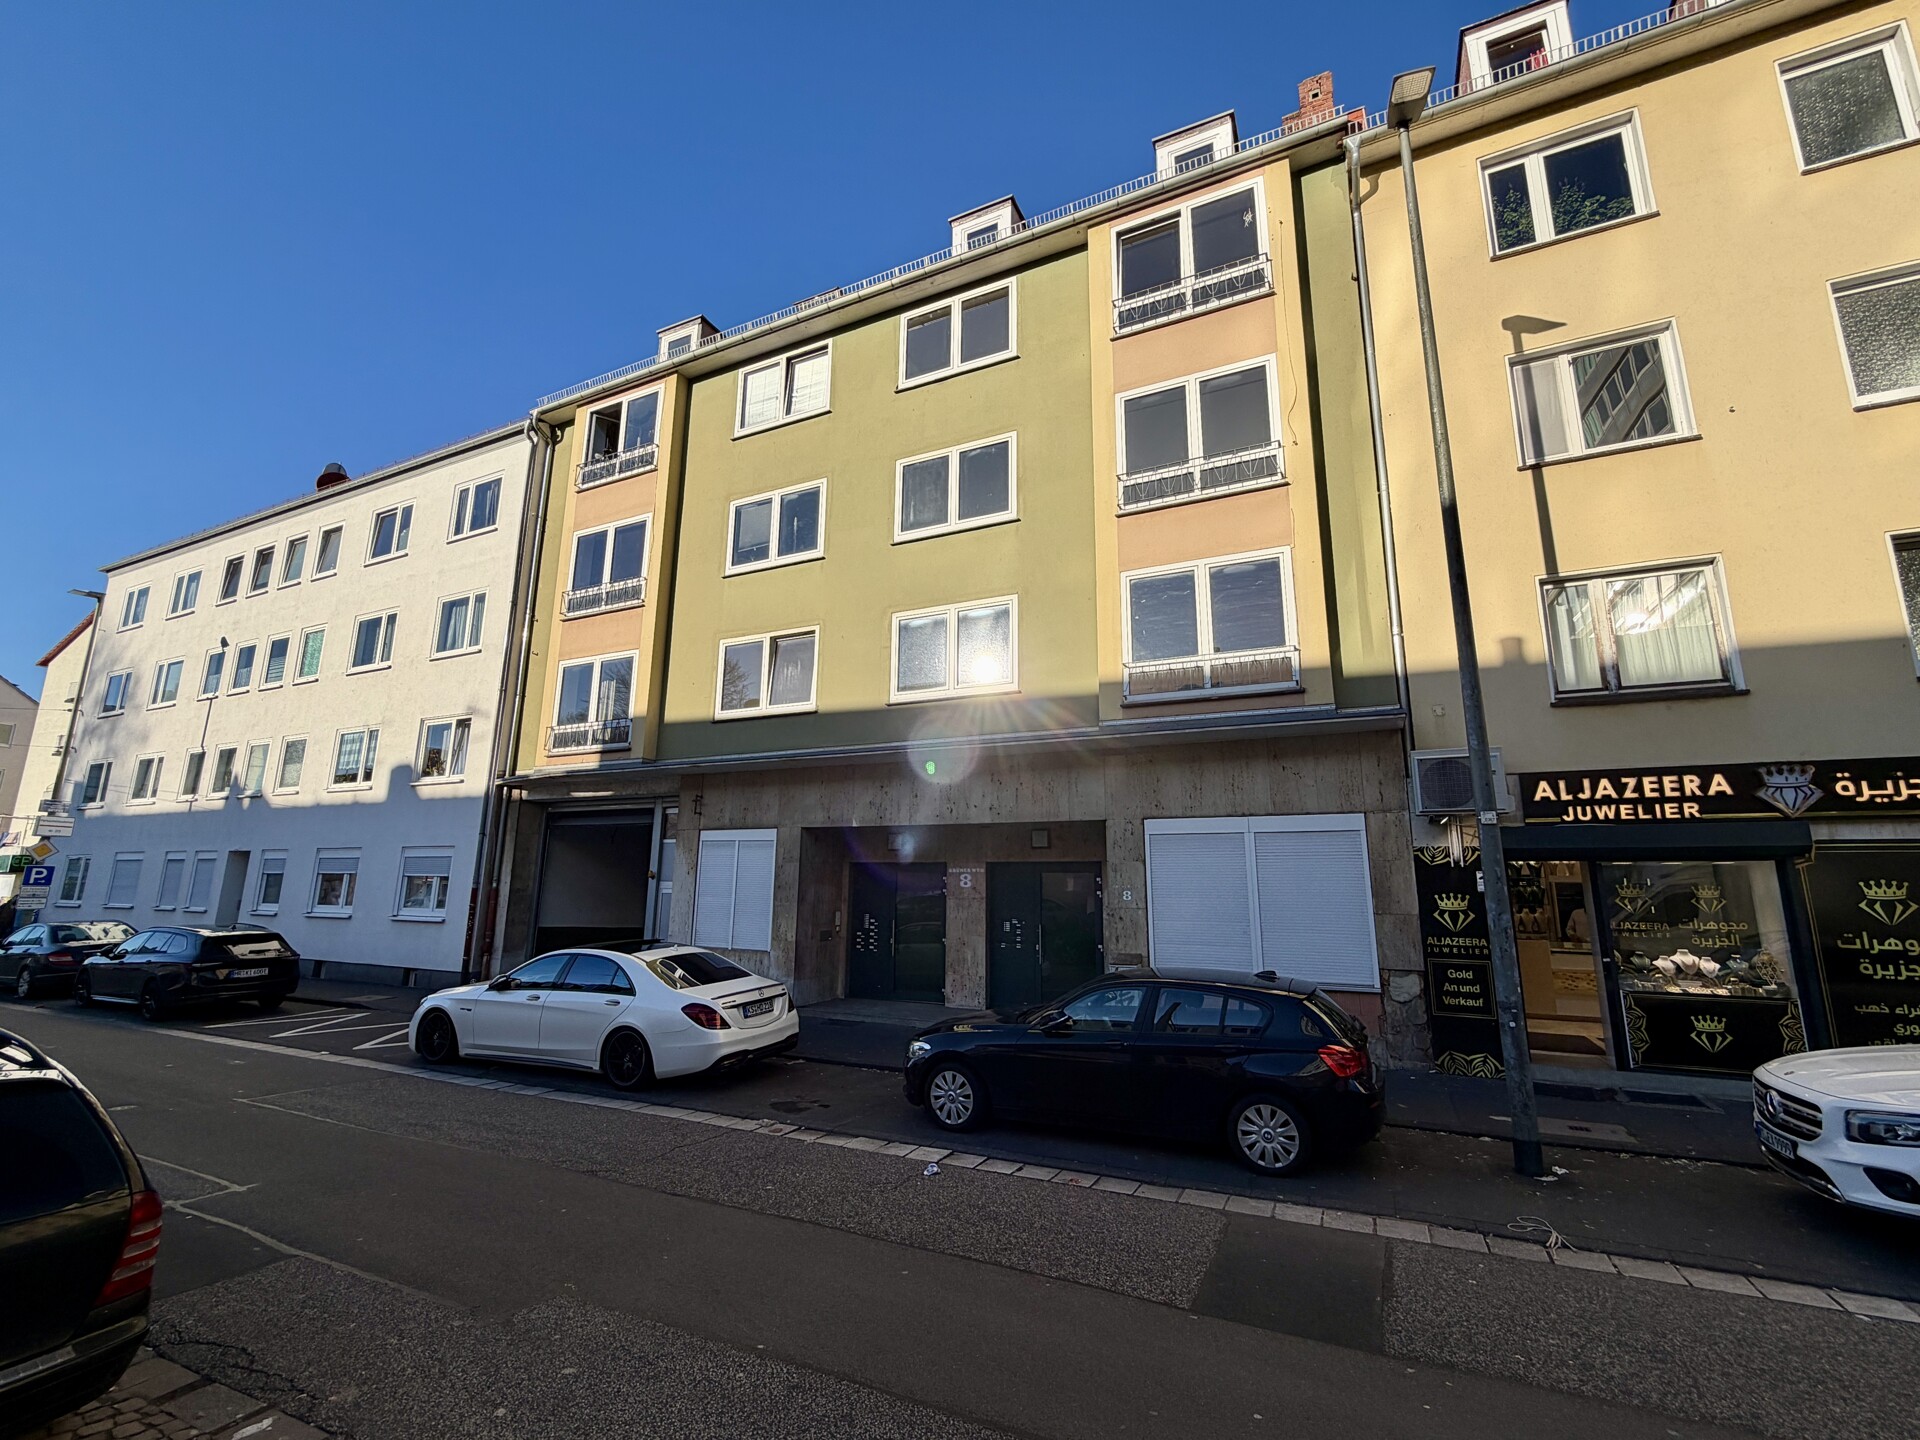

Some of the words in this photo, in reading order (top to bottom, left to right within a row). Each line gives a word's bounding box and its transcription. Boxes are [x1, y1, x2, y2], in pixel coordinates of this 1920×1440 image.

[1533, 773, 1734, 802] ALJAZEERA
[1562, 802, 1701, 821] JUWELIER
[29, 867, 48, 884] P
[960, 873, 972, 888] 8
[1122, 890, 1132, 901] 8
[1610, 921, 1670, 931] LJAZEERA
[1678, 917, 1749, 933] مجوهرات
[1426, 936, 1488, 947] ALJAZEERA
[1691, 934, 1741, 948] الجزيرة
[1427, 946, 1489, 955] JUWELIER
[1447, 969, 1473, 979] Gold
[1443, 982, 1458, 991] An
[1459, 984, 1480, 993] und
[1442, 995, 1484, 1007] Verkauf
